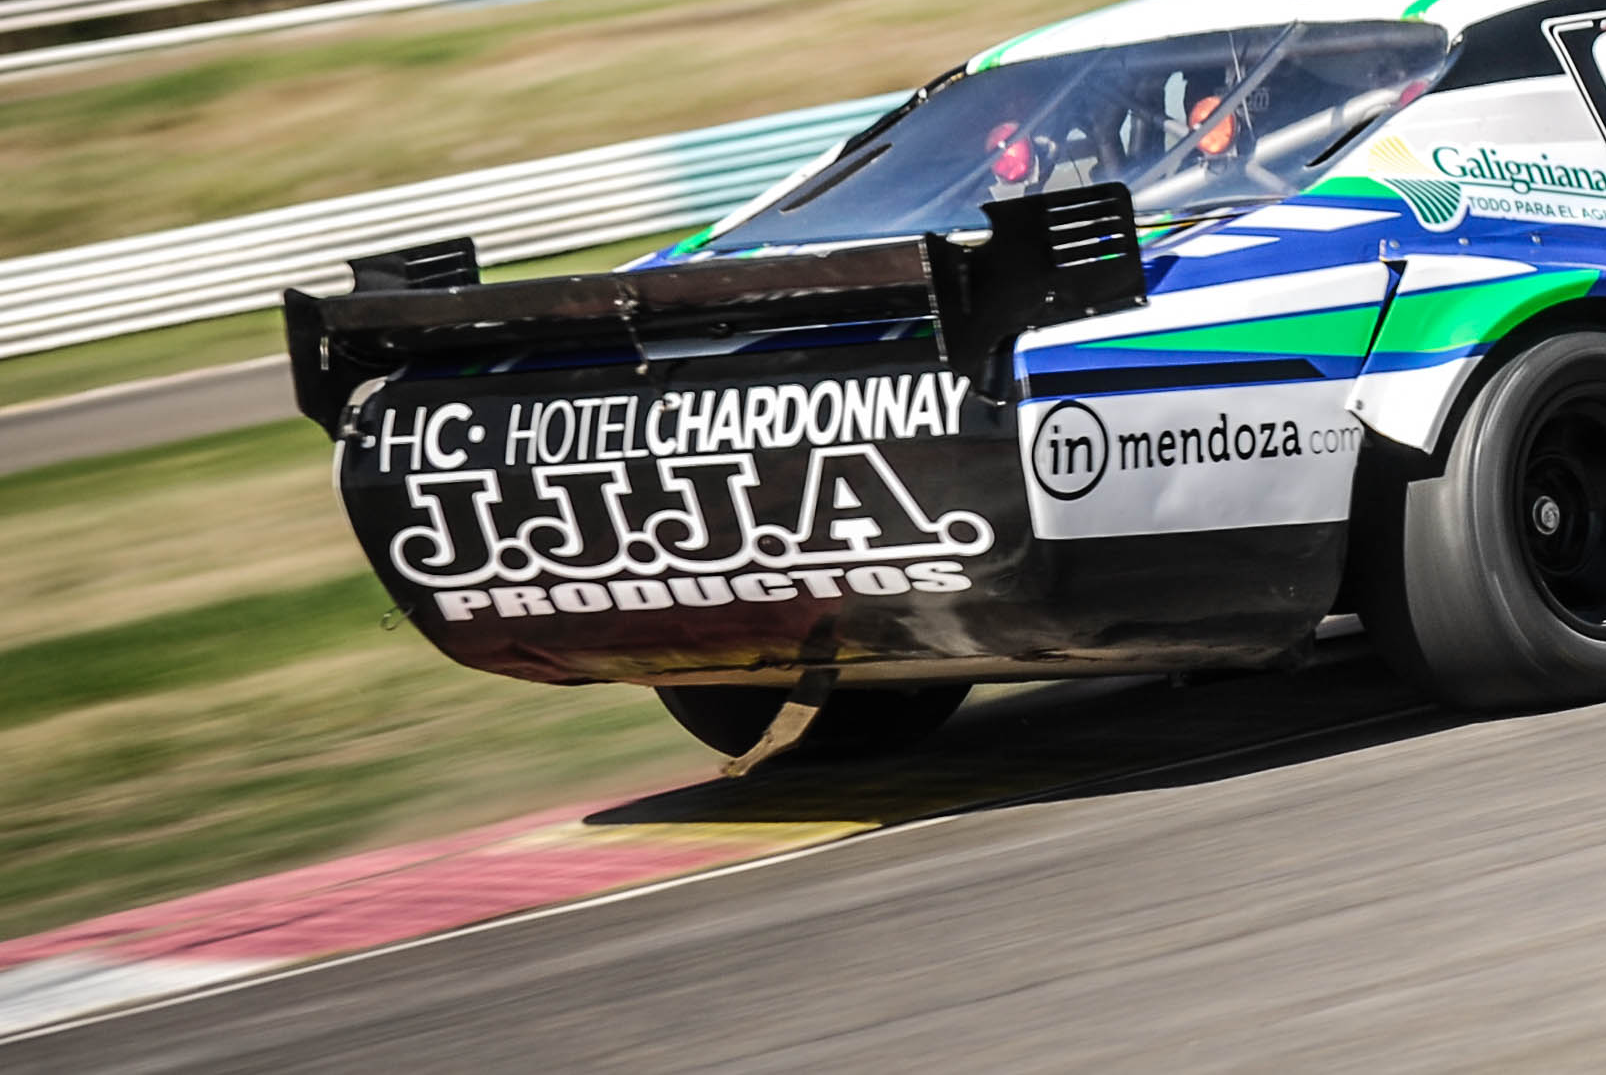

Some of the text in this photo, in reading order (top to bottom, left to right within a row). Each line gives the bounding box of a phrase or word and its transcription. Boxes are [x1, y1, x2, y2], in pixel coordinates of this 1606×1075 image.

[1468, 196, 1511, 213] TODO
[1515, 202, 1555, 217] PARA
[1560, 205, 1577, 218] EL
[505, 395, 650, 466] HOTEL
[646, 371, 971, 457] CHARDONNAY
[433, 560, 973, 622] PRODUCTOS
